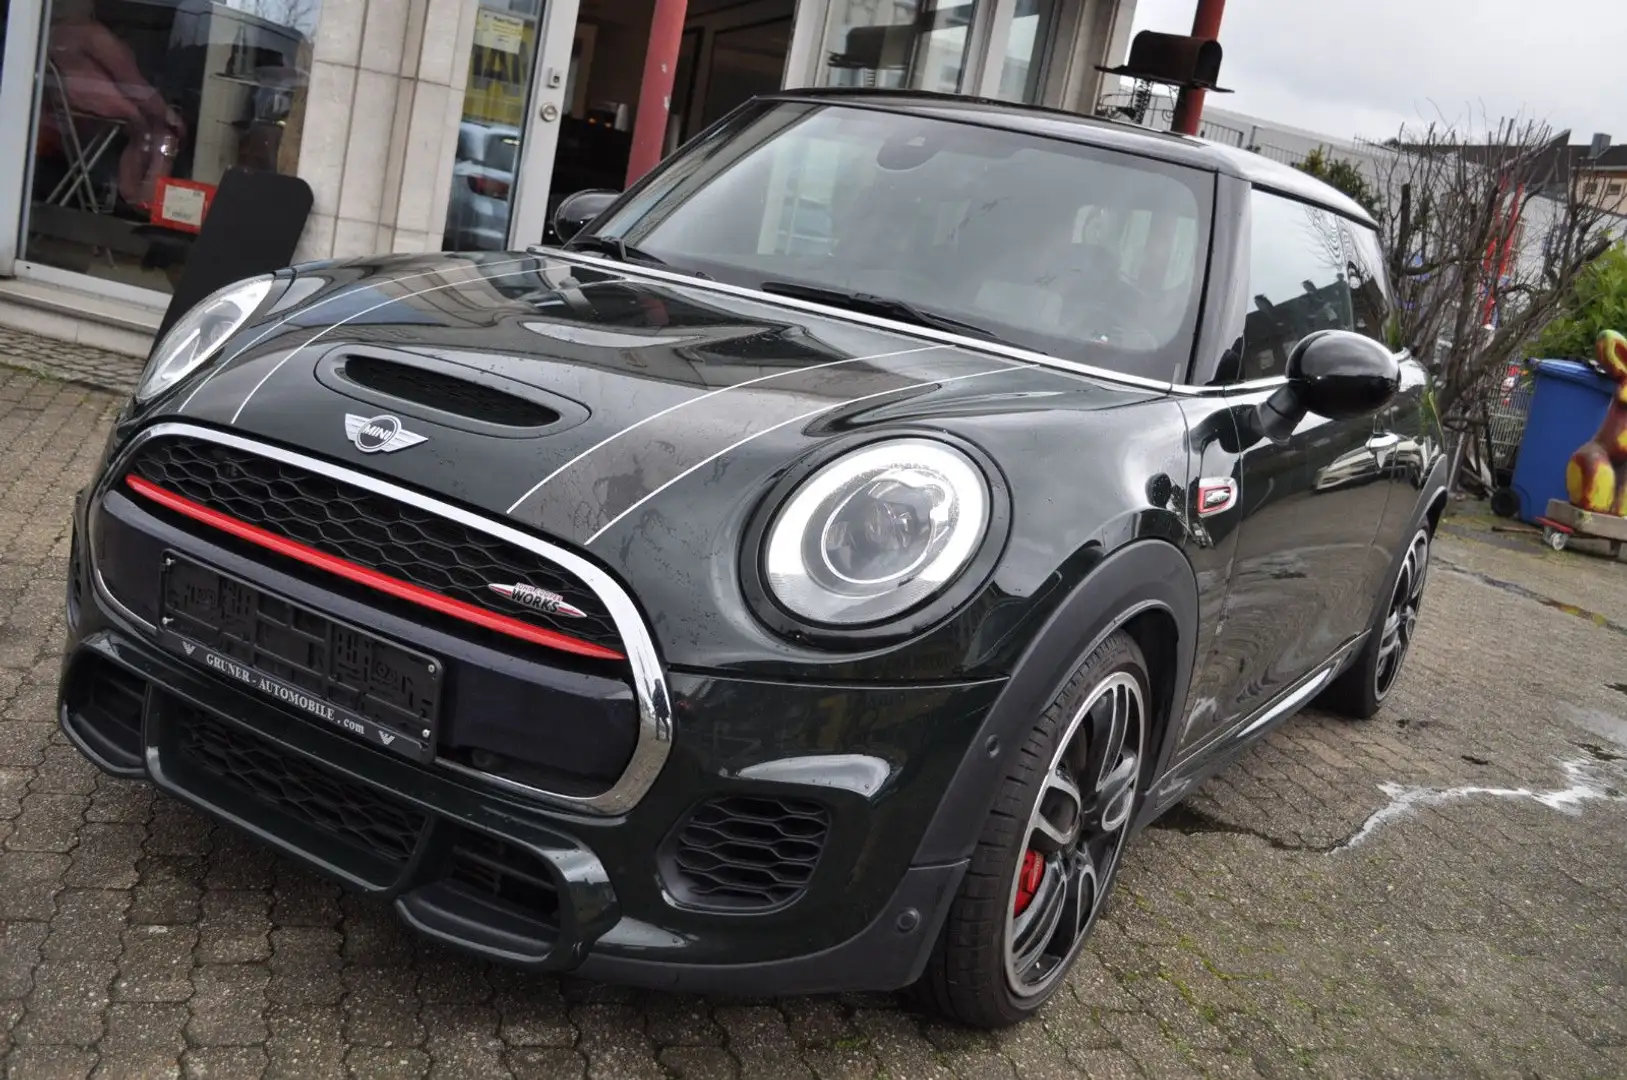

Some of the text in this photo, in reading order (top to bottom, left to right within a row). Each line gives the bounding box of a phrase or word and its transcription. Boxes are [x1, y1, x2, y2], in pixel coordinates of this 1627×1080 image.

[362, 424, 393, 440] MINI
[511, 589, 559, 612] WORKS
[259, 678, 335, 721] AUTOMOBILE
